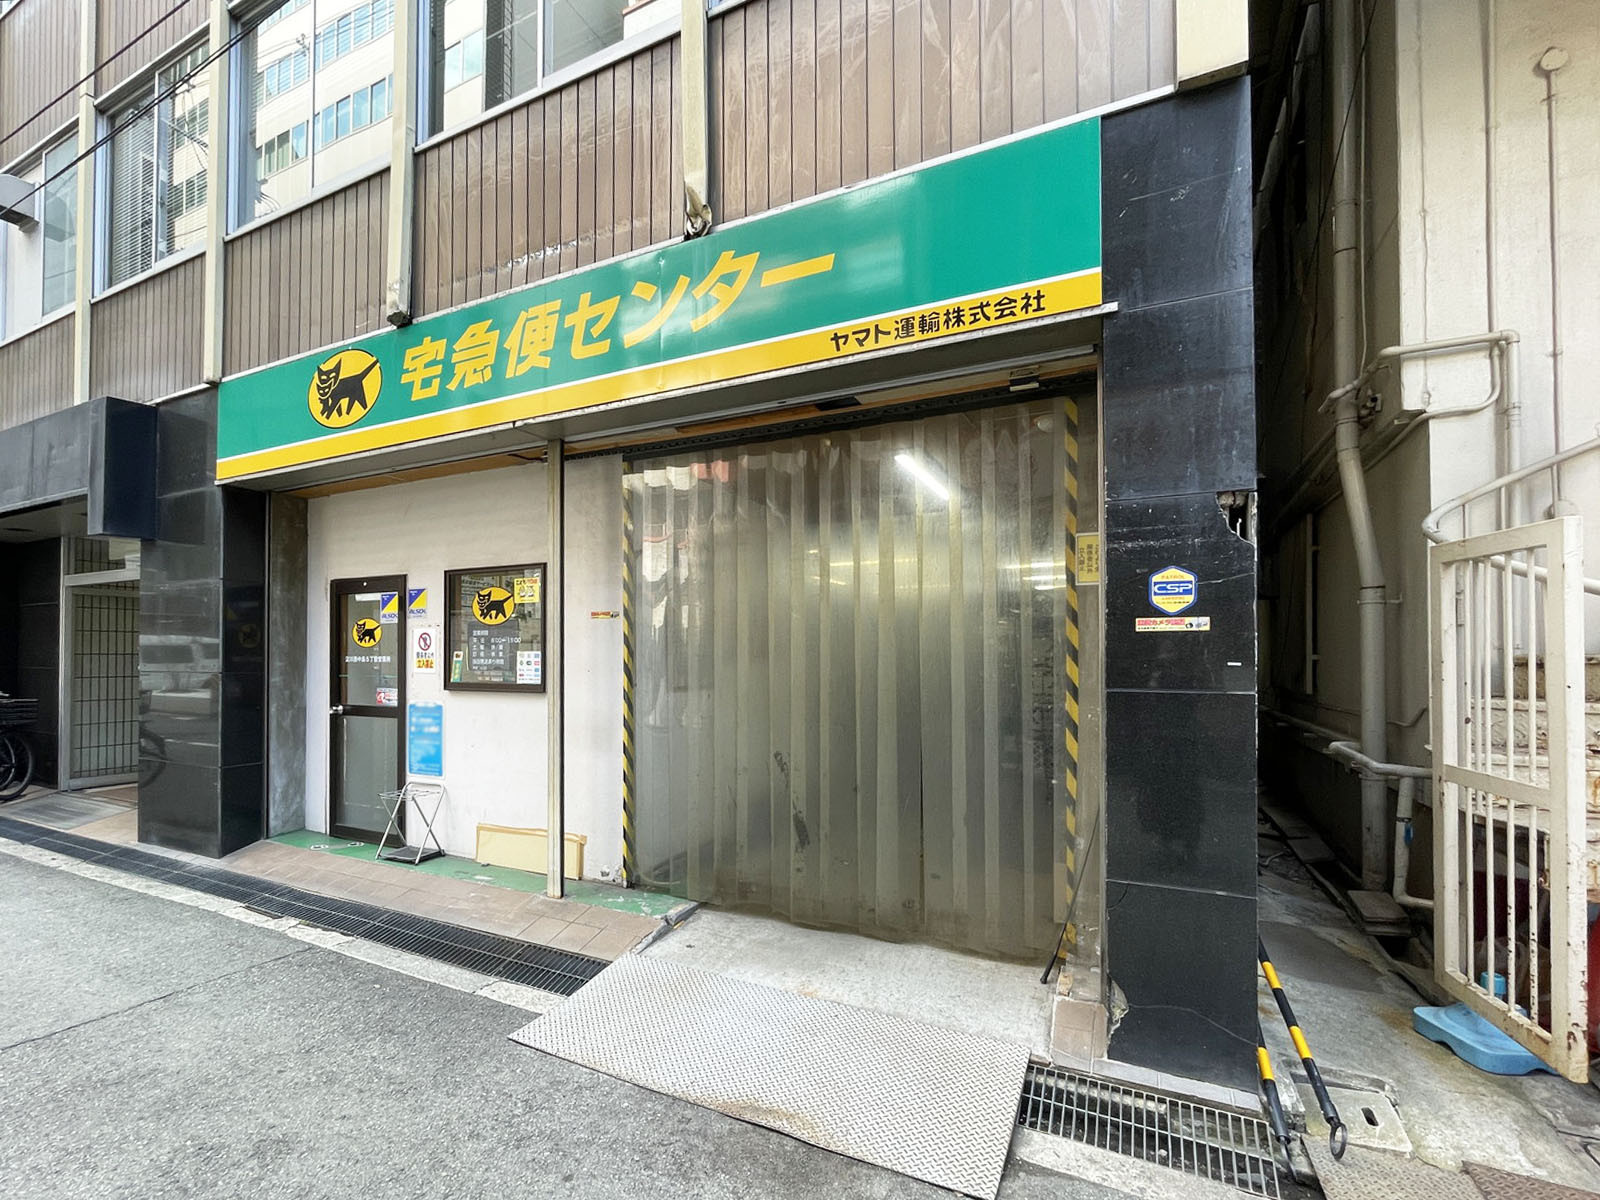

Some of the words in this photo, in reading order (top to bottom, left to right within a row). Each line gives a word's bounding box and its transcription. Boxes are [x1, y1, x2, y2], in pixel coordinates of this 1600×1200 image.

[401, 250, 836, 401] 宅急便センター
[830, 290, 1046, 352] ヤマト運輸株式会社
[1154, 583, 1193, 593] CSP
